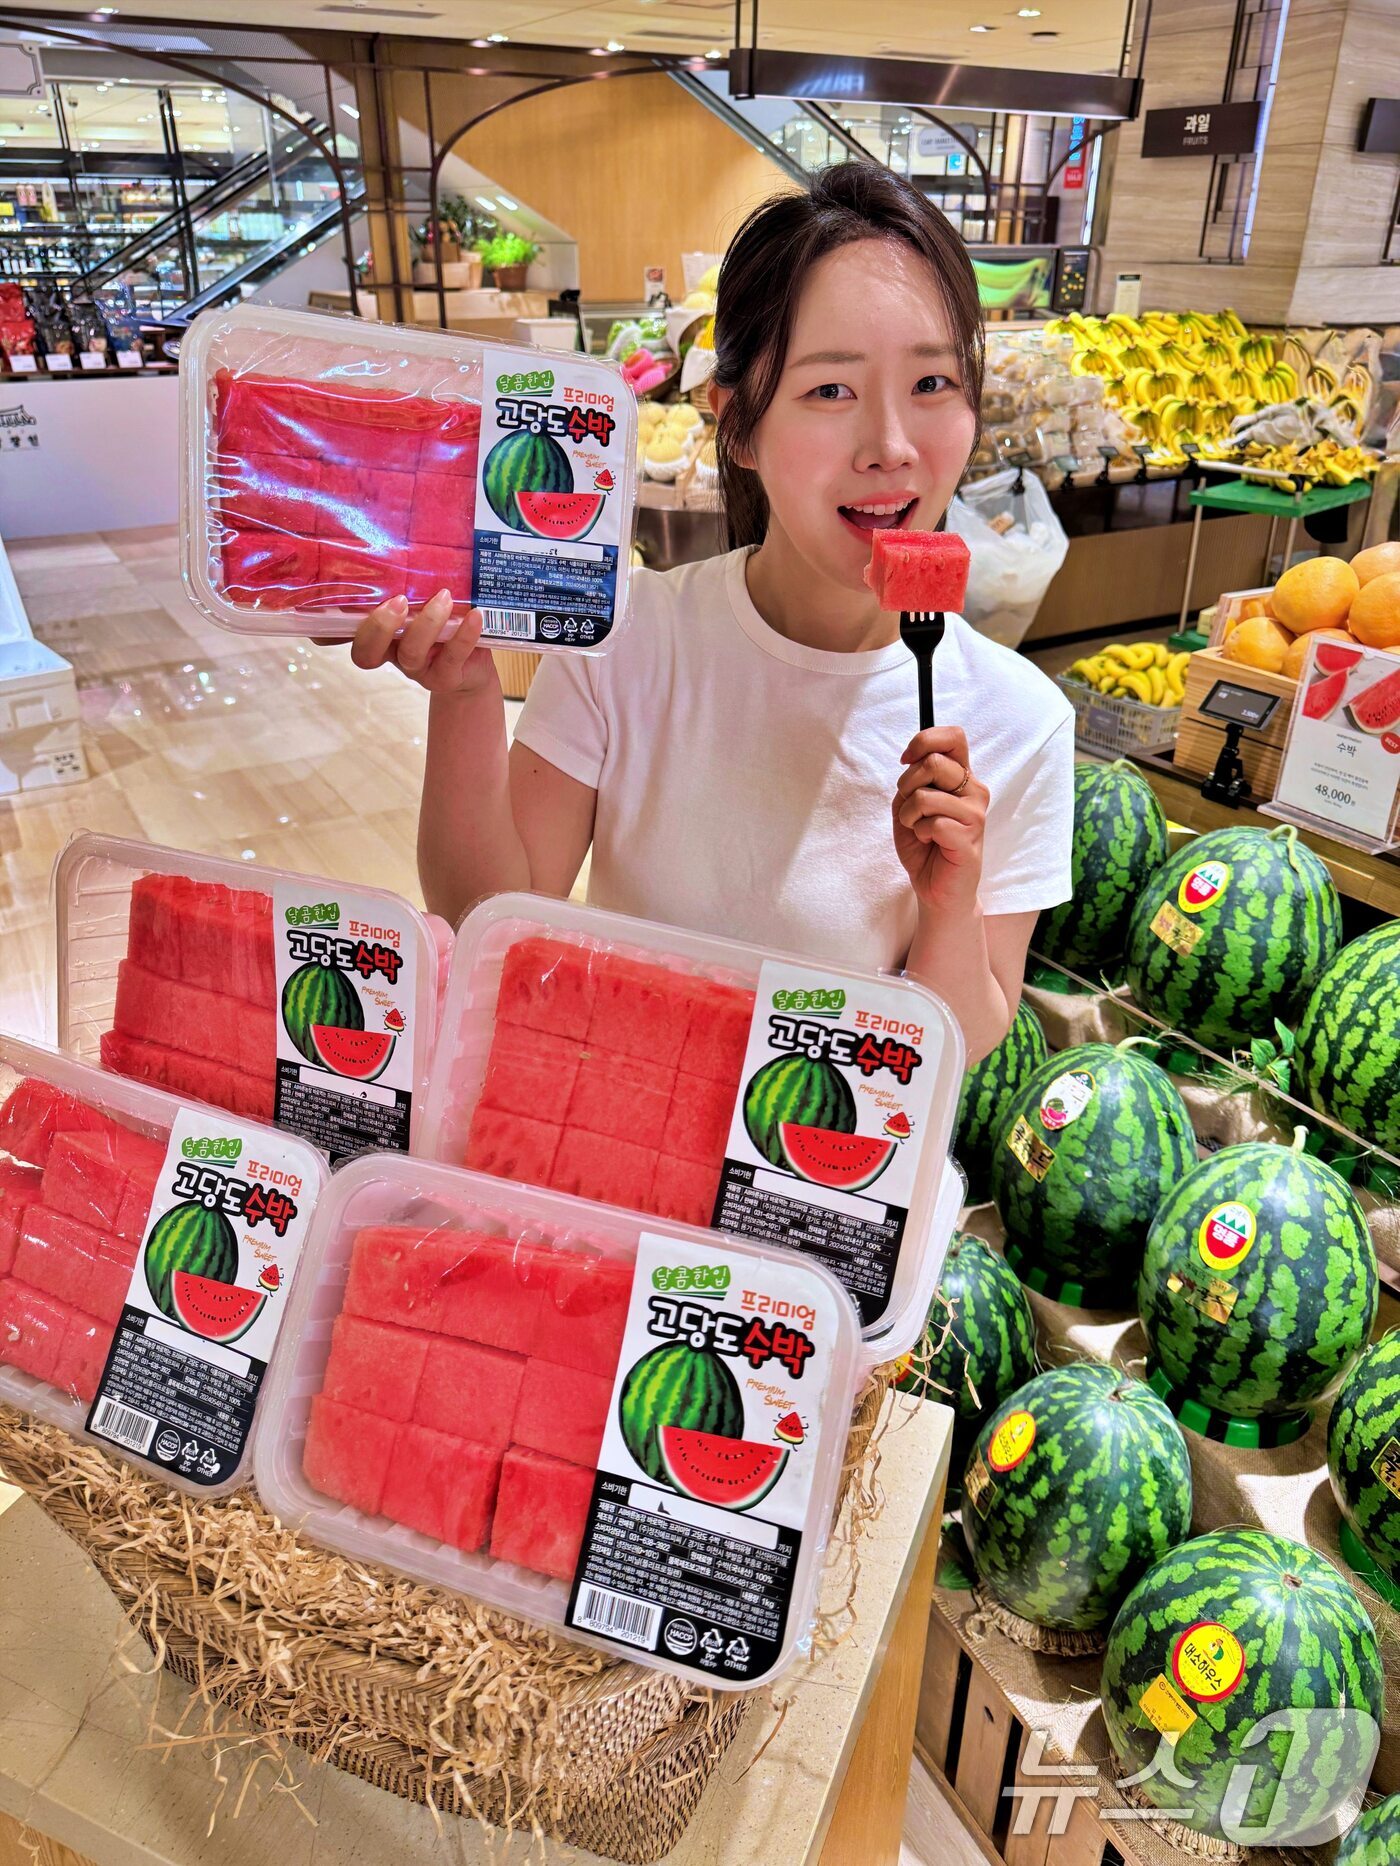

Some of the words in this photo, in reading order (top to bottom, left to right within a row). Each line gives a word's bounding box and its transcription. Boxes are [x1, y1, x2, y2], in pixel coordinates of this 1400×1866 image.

[1184, 113, 1210, 133] 과일
[1183, 136, 1208, 146] FRUITS
[563, 387, 614, 412] 프리미엄
[1336, 742, 1357, 757] 수박
[349, 920, 399, 948] 프리미엄
[855, 1010, 923, 1045] 프리미엄
[874, 1097, 903, 1111] SWEET
[246, 1160, 302, 1197] 프리미엄
[728, 1167, 751, 1179] 소비기한
[886, 1218, 898, 1229] 까지
[1212, 1223, 1240, 1249] 명품
[865, 1241, 882, 1252] 100%
[253, 1248, 277, 1263] SWEET
[870, 1261, 883, 1271] 1kg
[741, 1290, 816, 1330] 프리미엄
[763, 1394, 796, 1410] SWEET
[601, 1480, 627, 1496] 소비기한
[777, 1542, 792, 1555] 까지
[754, 1571, 773, 1584] 100%
[760, 1597, 774, 1608] 1kg
[620, 1629, 646, 1644] 201219
[669, 1628, 694, 1643] HACCP
[723, 1658, 748, 1673] OTHER
[1184, 1642, 1223, 1692] 대소하우스
